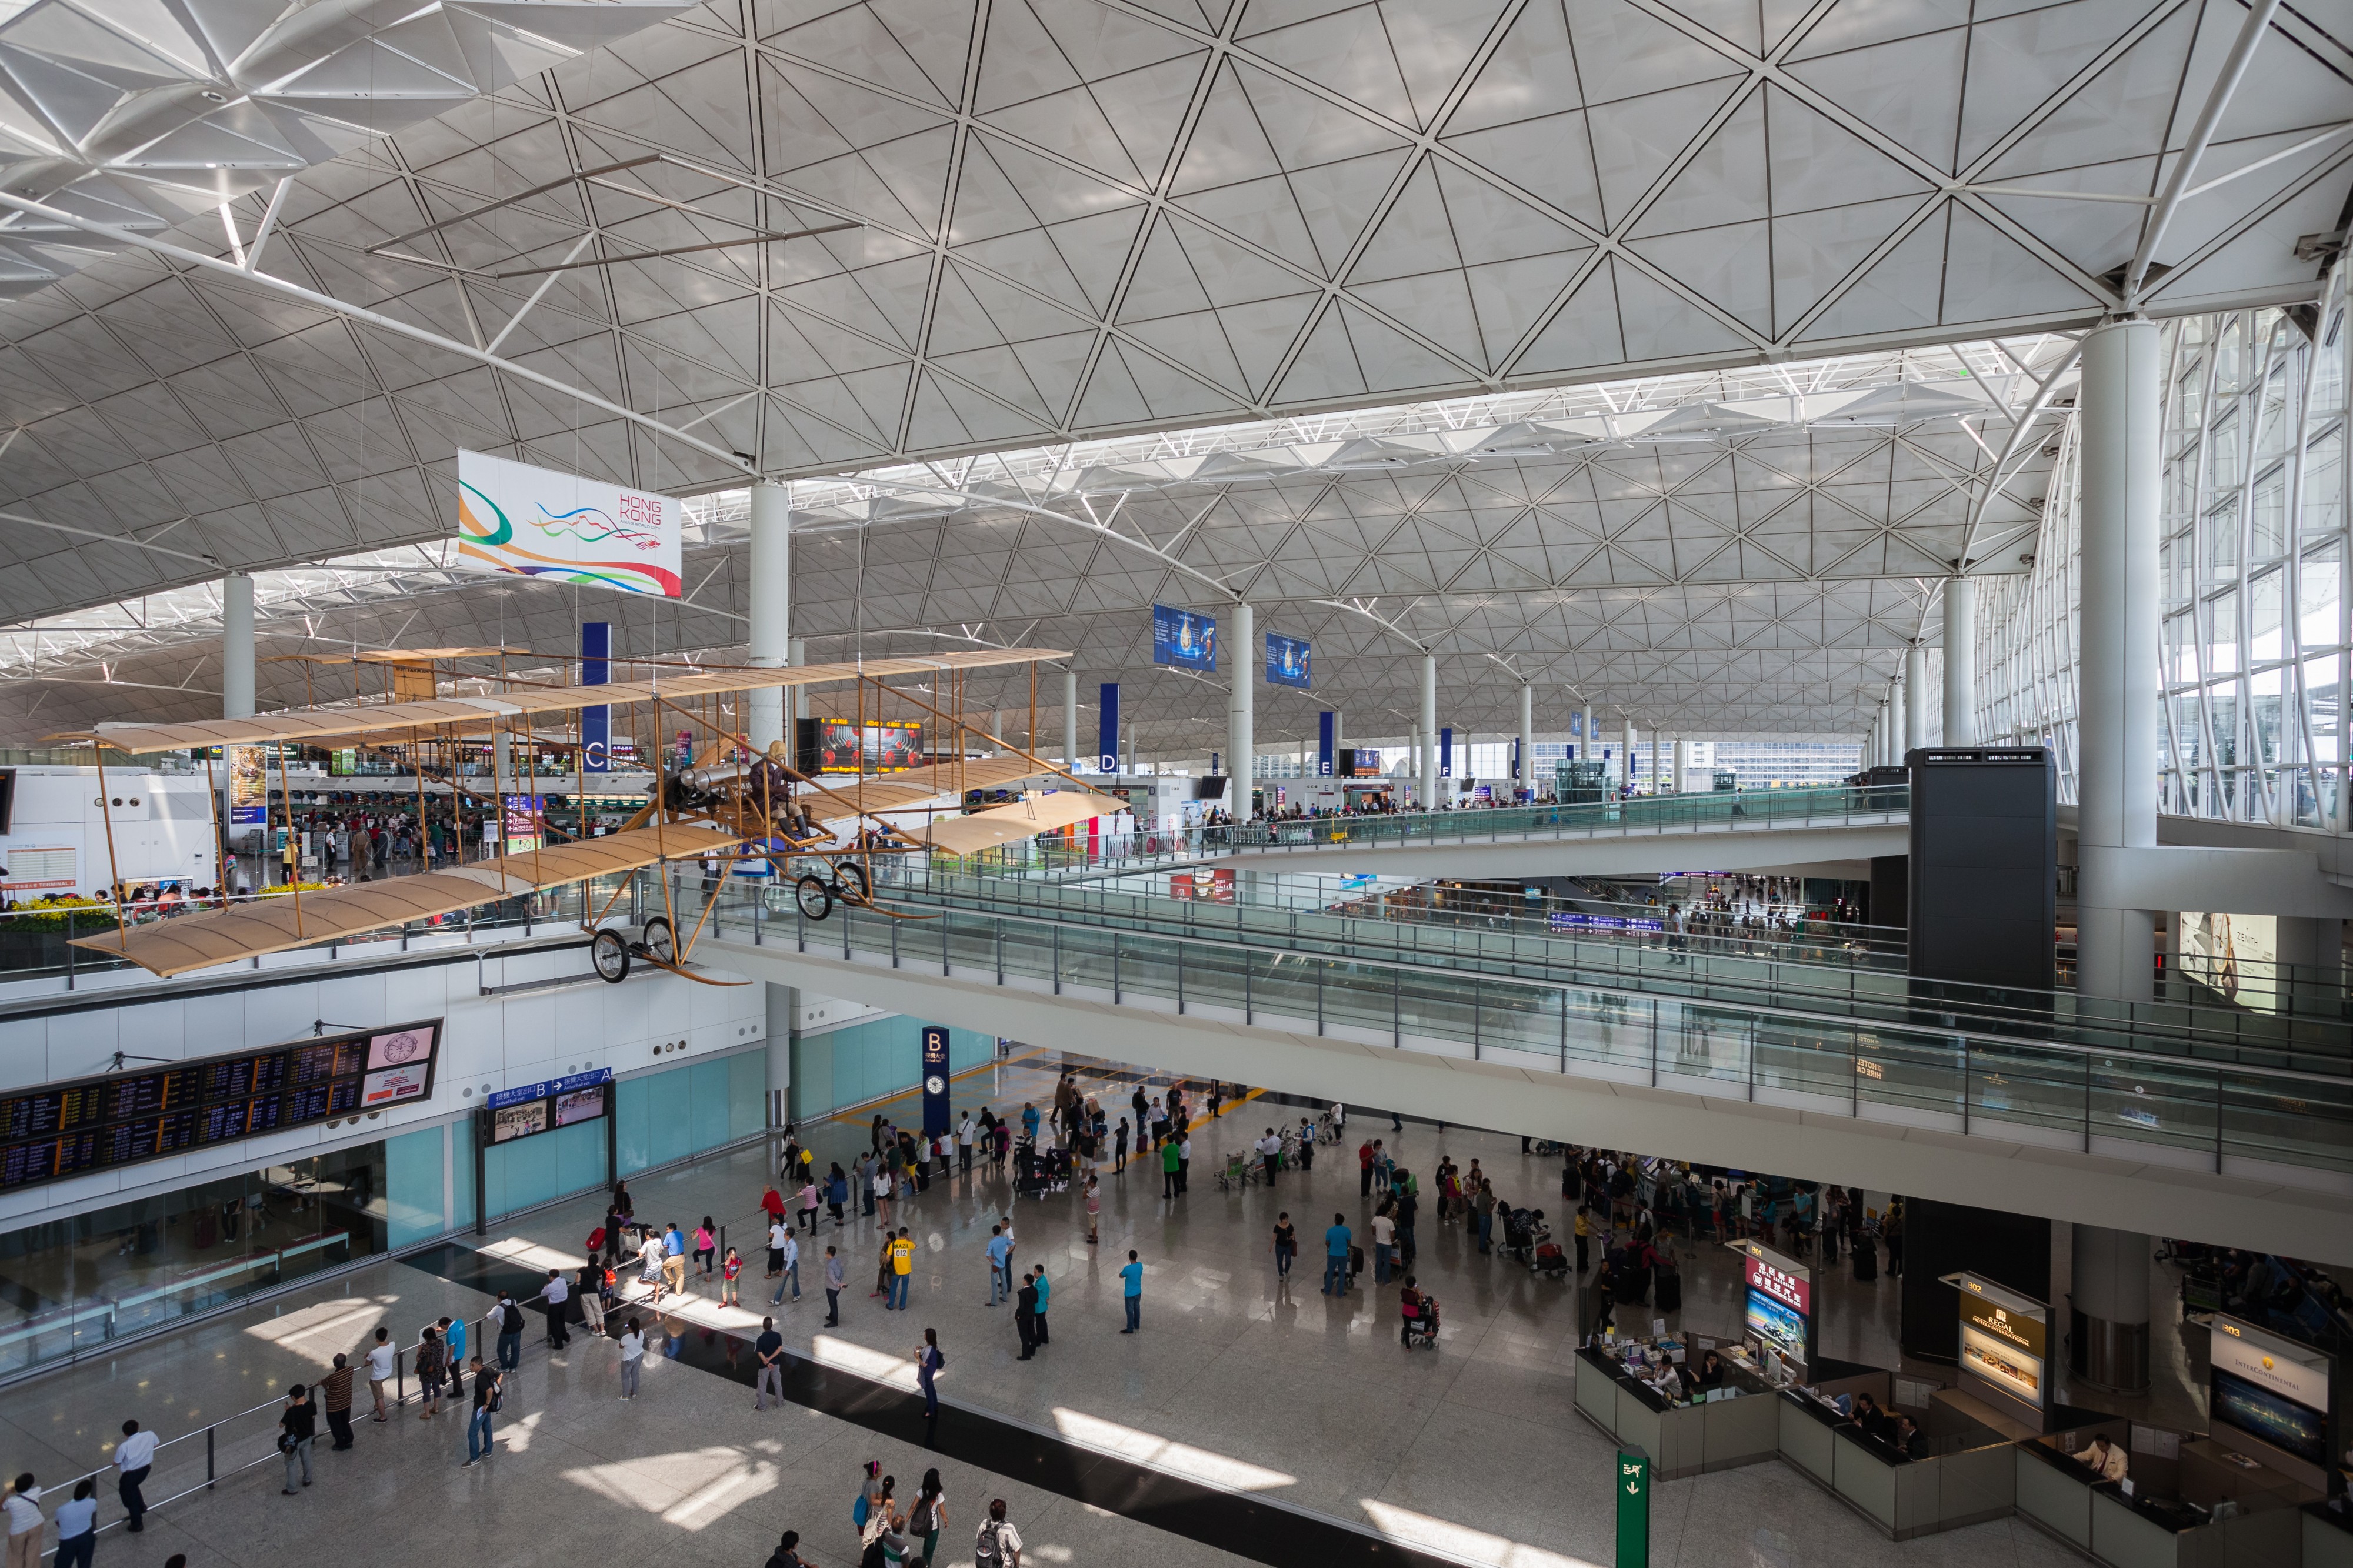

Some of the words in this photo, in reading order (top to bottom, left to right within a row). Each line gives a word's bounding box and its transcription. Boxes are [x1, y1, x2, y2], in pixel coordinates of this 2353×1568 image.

[620, 493, 661, 513] HONG
[620, 506, 661, 525] KONG
[586, 742, 604, 767] C
[1102, 755, 1115, 770] D
[1322, 762, 1329, 773] E
[1442, 767, 1449, 776] F
[1149, 787, 1156, 795] D
[2237, 932, 2258, 947] ZENITH
[929, 1033, 941, 1051] B
[565, 1071, 600, 1085] 接機大堂出口
[601, 1069, 611, 1082] A
[496, 1086, 536, 1102] 接機大堂出口
[537, 1084, 545, 1097] B
[1752, 1246, 1761, 1256] B01
[1759, 1269, 1771, 1278] HOTEL
[1774, 1276, 1795, 1290] LIMOUSINE
[1968, 1282, 1981, 1293] B02
[1973, 1317, 1991, 1328] HOTELS
[1991, 1325, 2030, 1347] INTERNATIONAL
[1988, 1316, 2014, 1334] REGAL
[2222, 1323, 2240, 1337] B03
[2235, 1359, 2299, 1390] INTERCONTINENTAL
